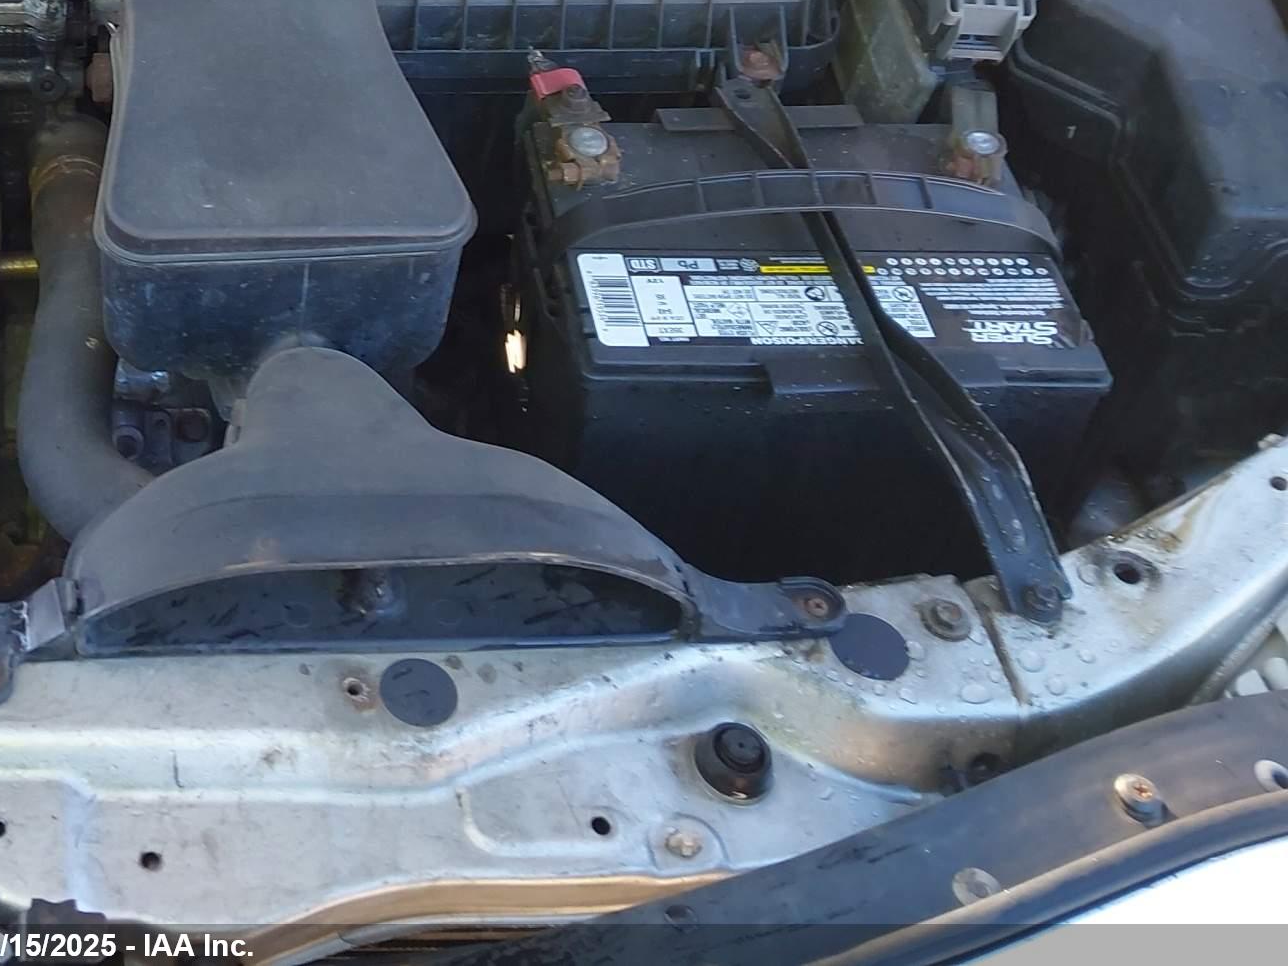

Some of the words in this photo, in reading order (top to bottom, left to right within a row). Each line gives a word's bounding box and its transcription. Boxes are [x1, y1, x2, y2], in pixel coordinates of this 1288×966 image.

[631, 259, 657, 270] STD
[678, 260, 698, 269] Pb
[960, 321, 1058, 335] START
[970, 332, 1053, 345] SUPER
